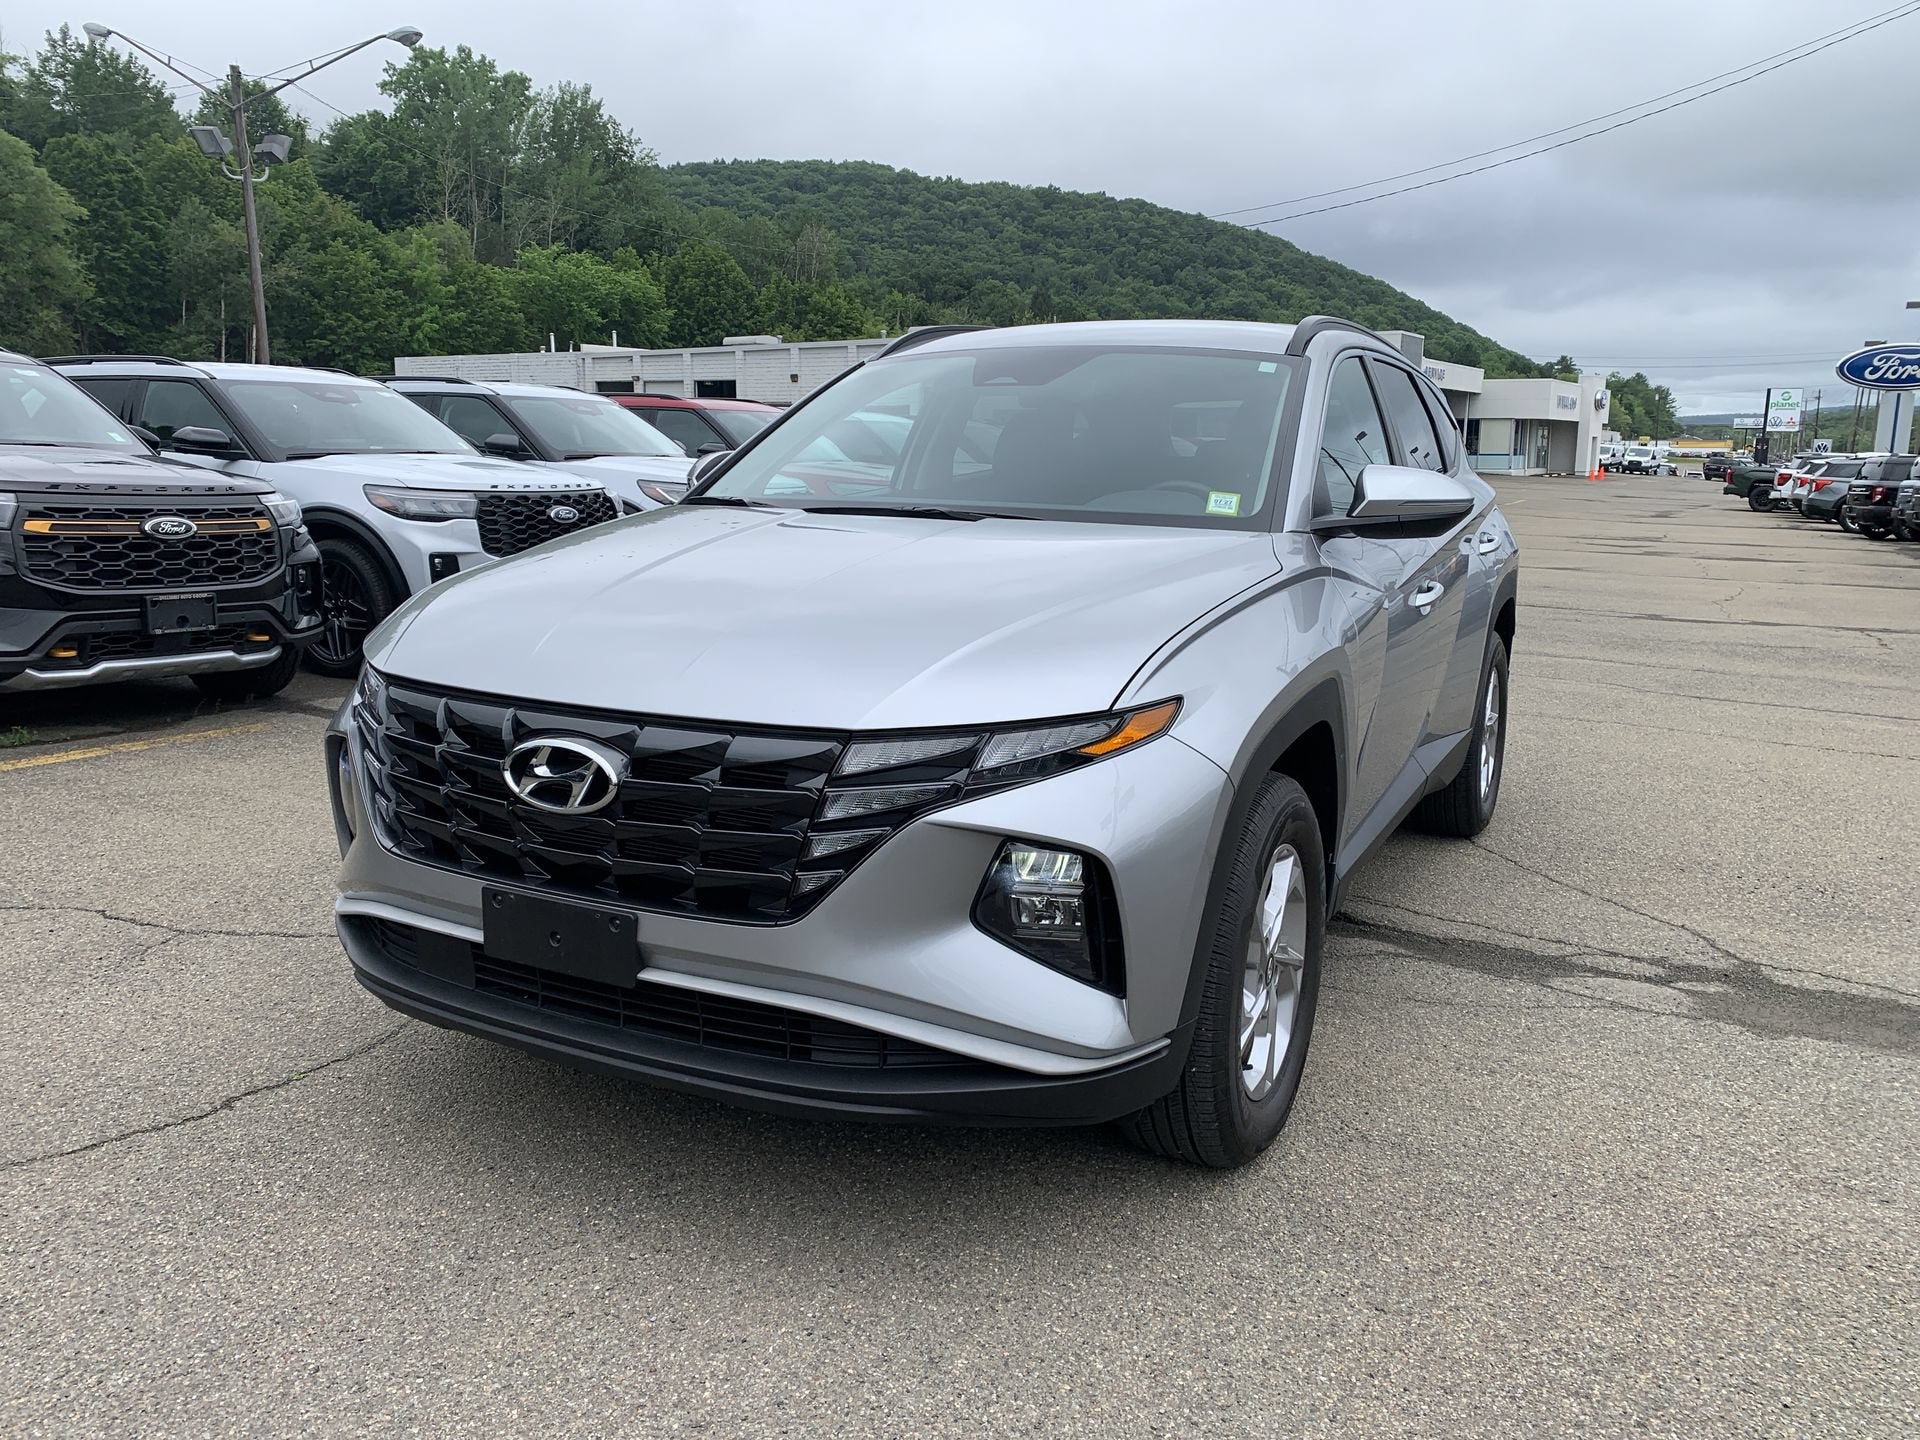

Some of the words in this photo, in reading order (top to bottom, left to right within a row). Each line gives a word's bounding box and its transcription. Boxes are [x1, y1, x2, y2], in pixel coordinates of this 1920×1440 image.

[1864, 353, 1920, 380] For
[1770, 400, 1801, 410] planet
[45, 484, 236, 492] EXPLORER
[159, 521, 186, 534] Ford
